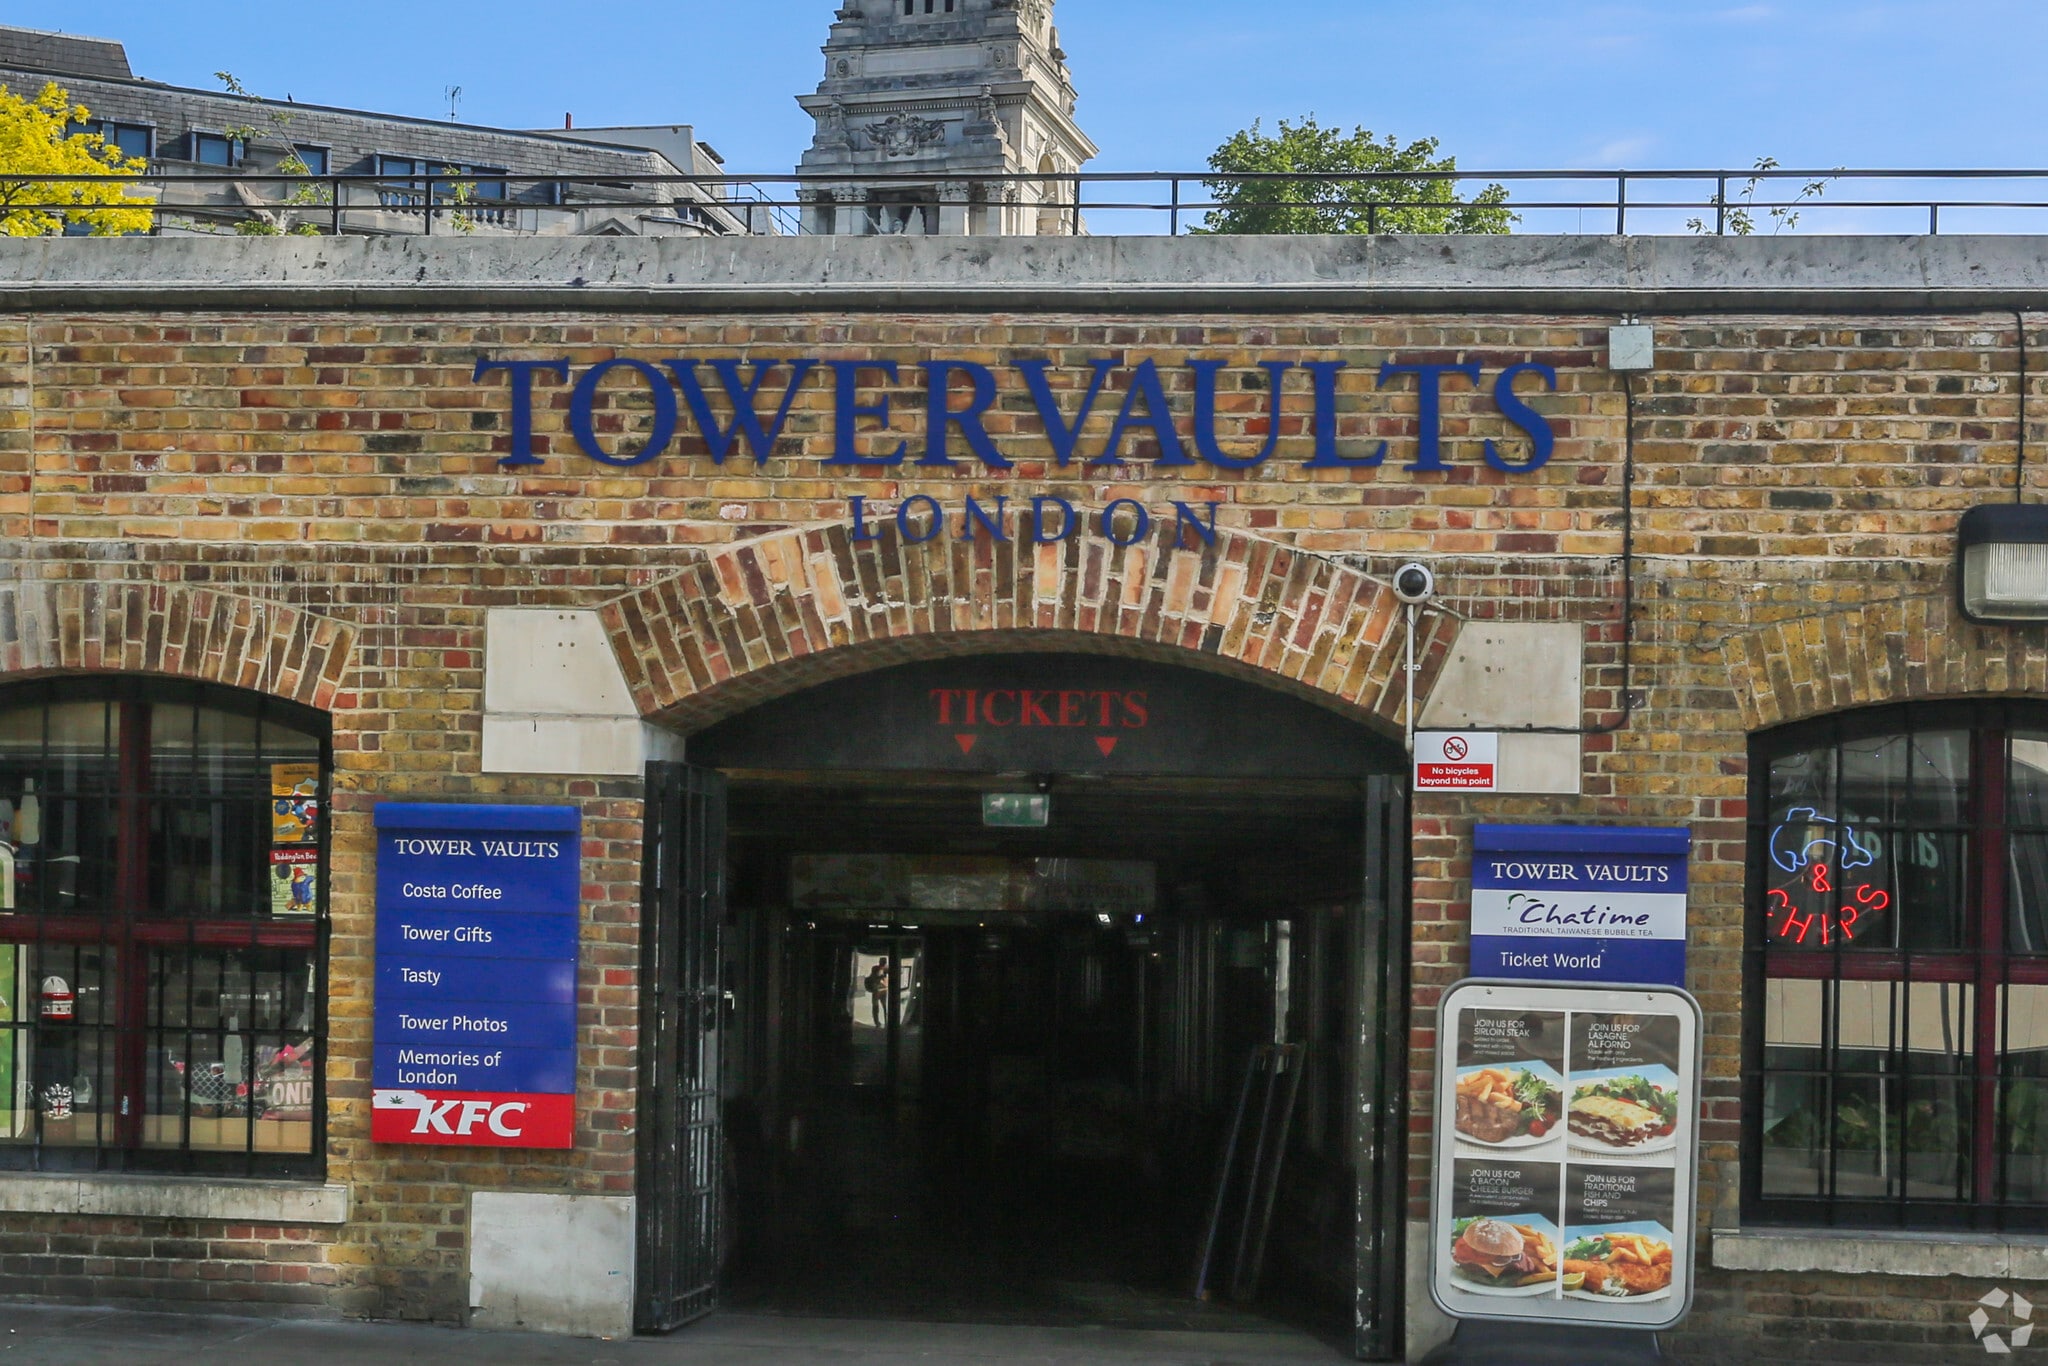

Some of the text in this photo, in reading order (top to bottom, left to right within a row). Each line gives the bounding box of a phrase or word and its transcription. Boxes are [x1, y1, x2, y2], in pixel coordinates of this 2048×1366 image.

[847, 493, 1219, 549] LONDON
[929, 688, 1148, 729] TICKETS
[1432, 767, 1479, 776] No bicycles
[1420, 776, 1490, 786] beyond this point
[395, 839, 559, 859] TOWER VAULTS
[1491, 862, 1669, 883] TOWER VAULTS
[403, 882, 502, 899] Costa Coffee
[1519, 903, 1650, 926] Chatime
[401, 924, 493, 943] Tower Gifts
[1503, 926, 1653, 937] TRADITIONAL TAIWANESE BUBBLE TEA
[1500, 952, 1601, 969] Ticket World
[401, 968, 441, 986] Tasty
[399, 1014, 508, 1032] Tower Photos
[1474, 1019, 1525, 1029] JOIN US FOR
[1588, 1023, 1640, 1033] JOIN US FOR
[1474, 1028, 1530, 1037] SIRLOIN STEAK
[1588, 1032, 1627, 1041] LASAGNE
[1588, 1040, 1631, 1049] AL FORNO
[398, 1050, 503, 1067] Memories of
[398, 1069, 457, 1085] London
[411, 1100, 526, 1137] KFC
[1470, 1169, 1520, 1179] JOIN US FOR
[1584, 1174, 1636, 1184] JOIN US FOR
[1470, 1177, 1509, 1186] A BACON
[1470, 1185, 1534, 1195] CHEESE BURGER
[1584, 1182, 1636, 1192] TRADITIONAL
[1602, 1191, 1621, 1200] AND
[1583, 1198, 1608, 1207] CHIPS
